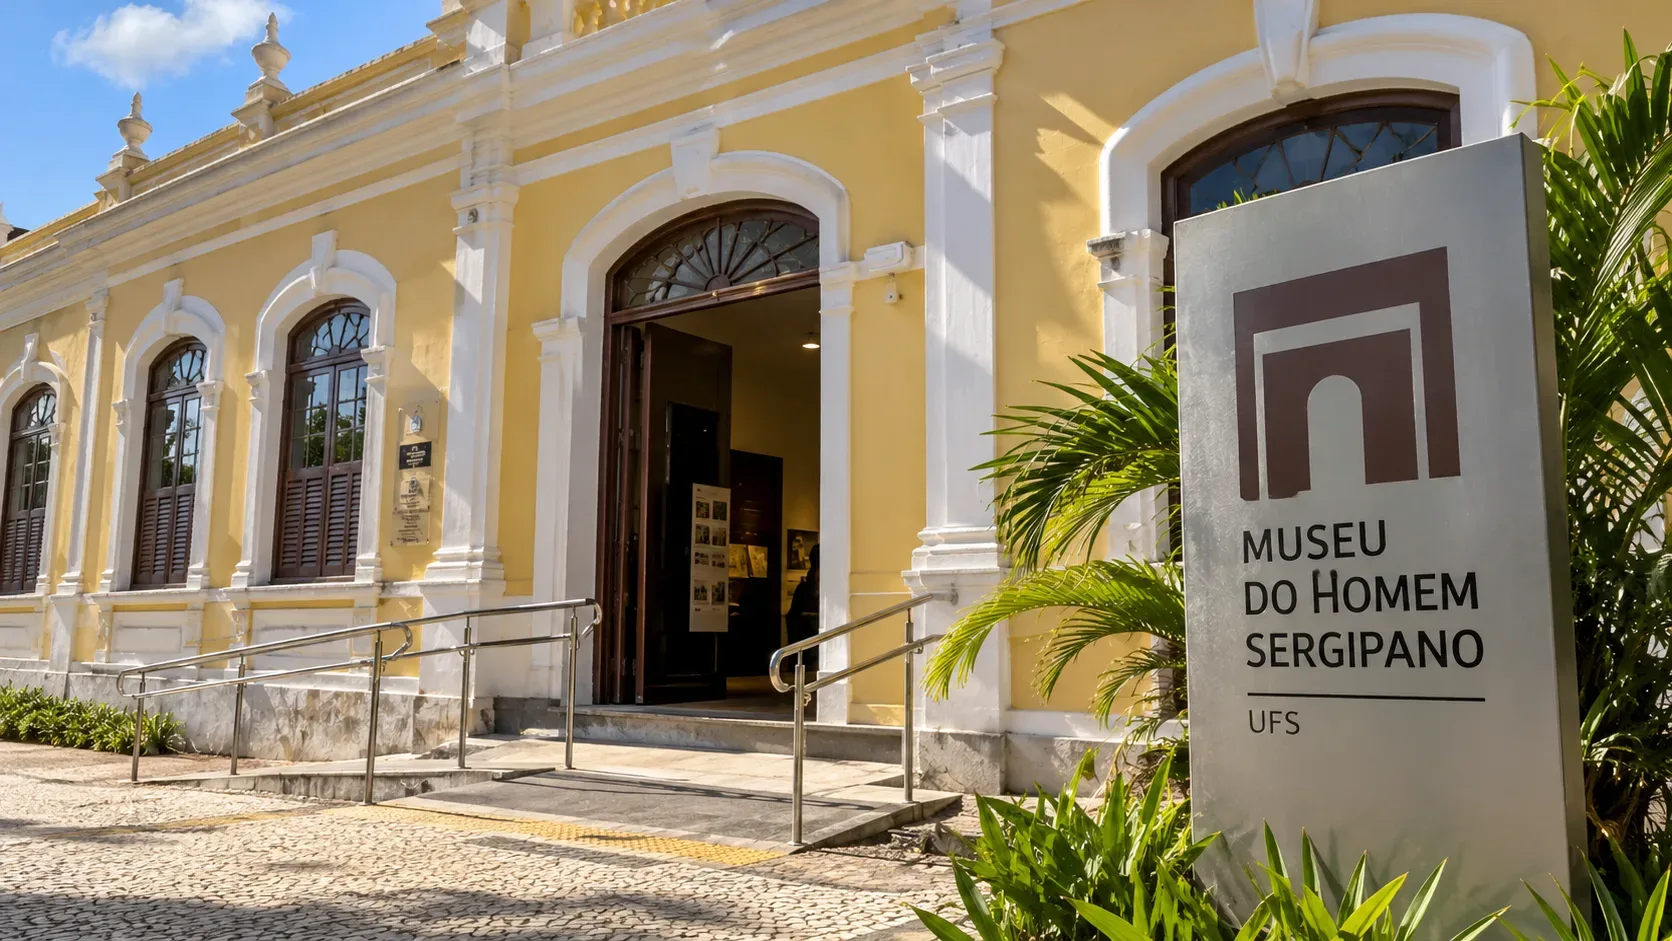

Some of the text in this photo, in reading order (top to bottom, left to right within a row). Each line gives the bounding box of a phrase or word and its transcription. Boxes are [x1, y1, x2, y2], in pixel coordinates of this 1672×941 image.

[1243, 520, 1387, 563] MUSEU
[1244, 569, 1479, 615] DO HOMEM
[1246, 629, 1484, 669] SERGIPANO
[1249, 709, 1300, 735] UFS
